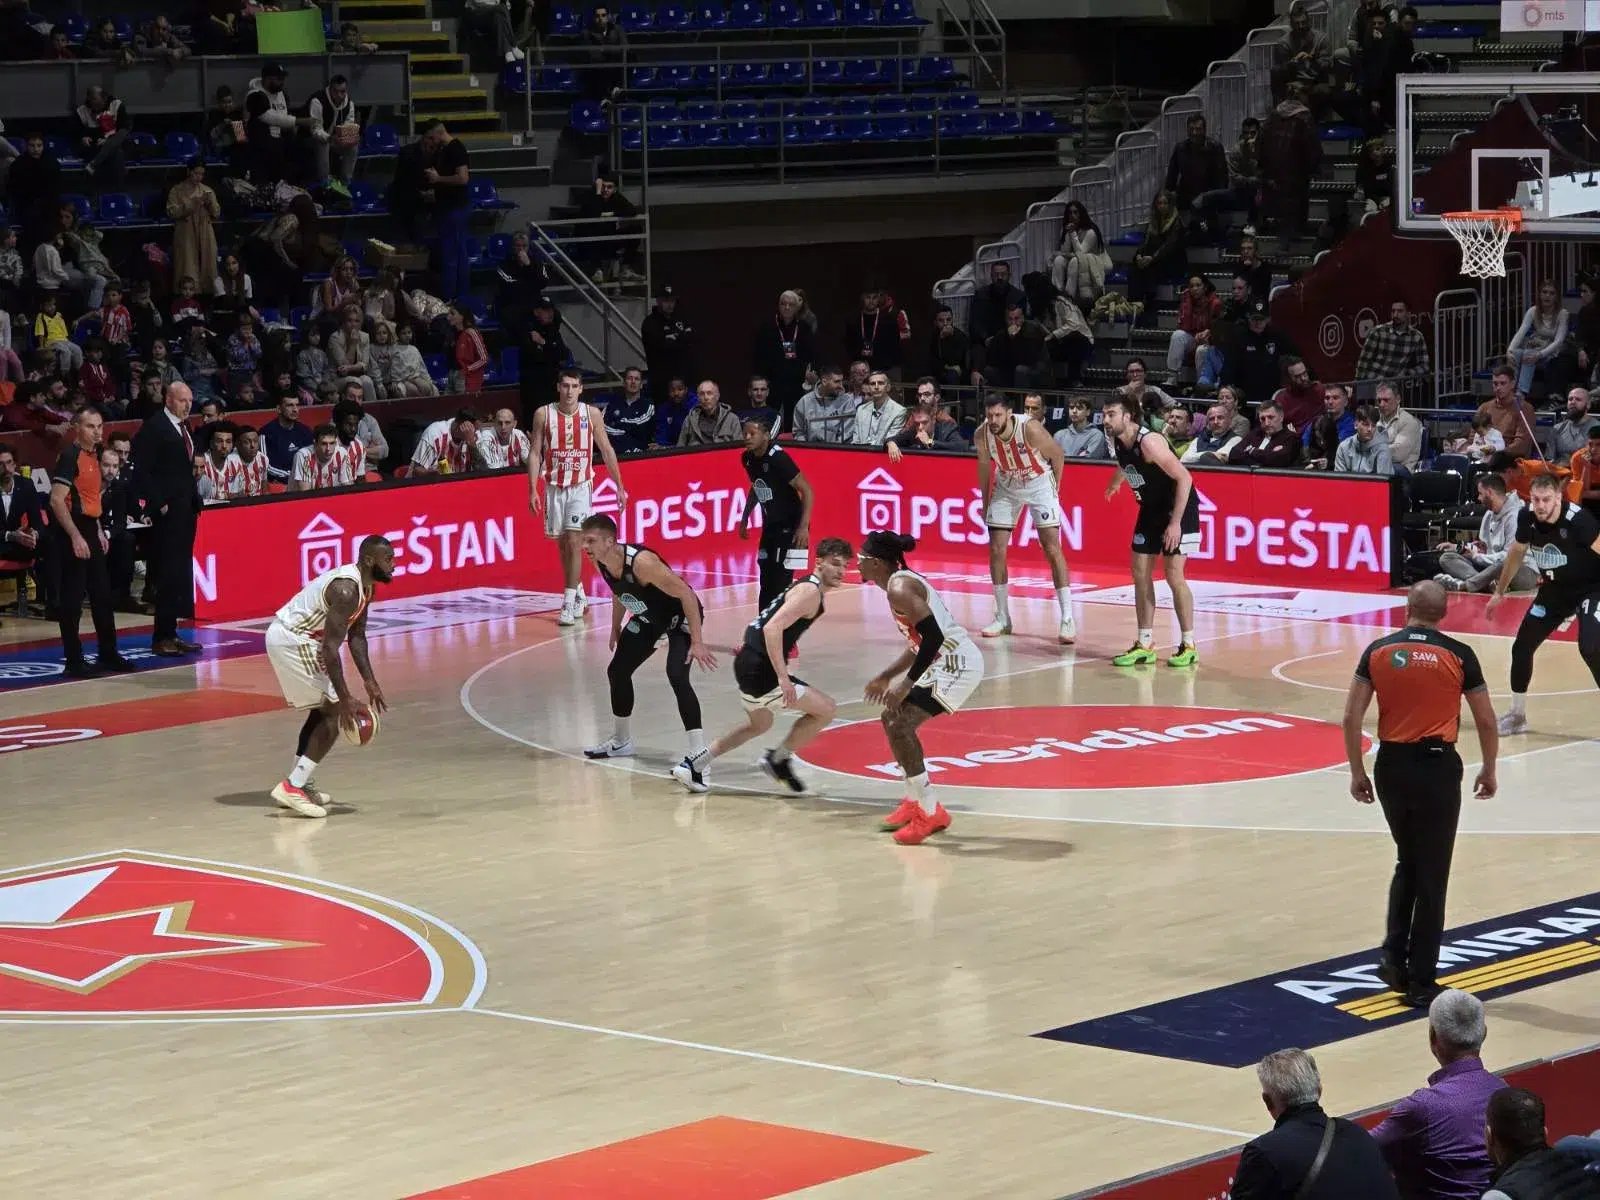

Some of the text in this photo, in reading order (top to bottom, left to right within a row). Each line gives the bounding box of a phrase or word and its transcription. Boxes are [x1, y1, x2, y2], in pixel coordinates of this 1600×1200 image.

[552, 448, 588, 459] meridian
[635, 480, 763, 545] PEŠTA
[1412, 651, 1438, 662] SAVA
[864, 713, 1294, 776] meridian
